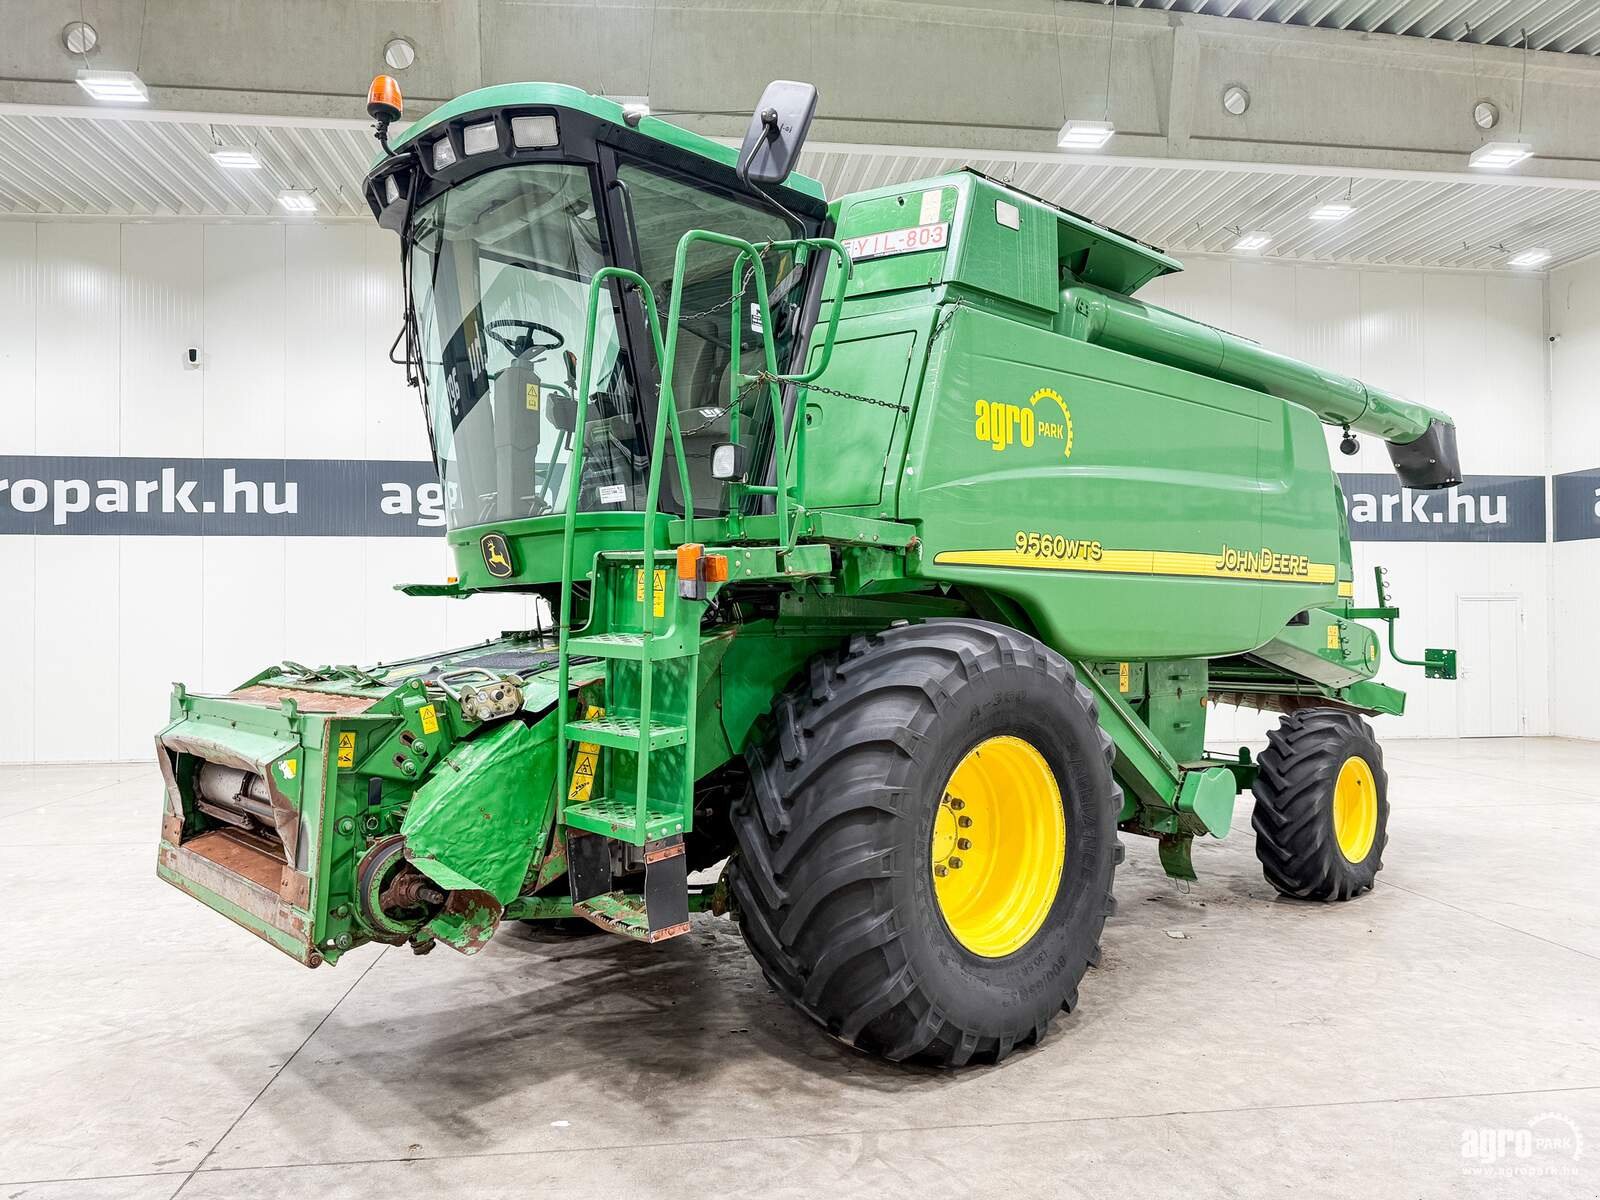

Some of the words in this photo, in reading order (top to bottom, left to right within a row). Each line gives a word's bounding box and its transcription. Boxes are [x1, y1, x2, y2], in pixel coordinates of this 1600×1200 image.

[857, 226, 943, 256] YIL-803
[975, 399, 1034, 451] agro
[1038, 421, 1064, 440] PARK
[1344, 485, 1507, 524] ark.hu
